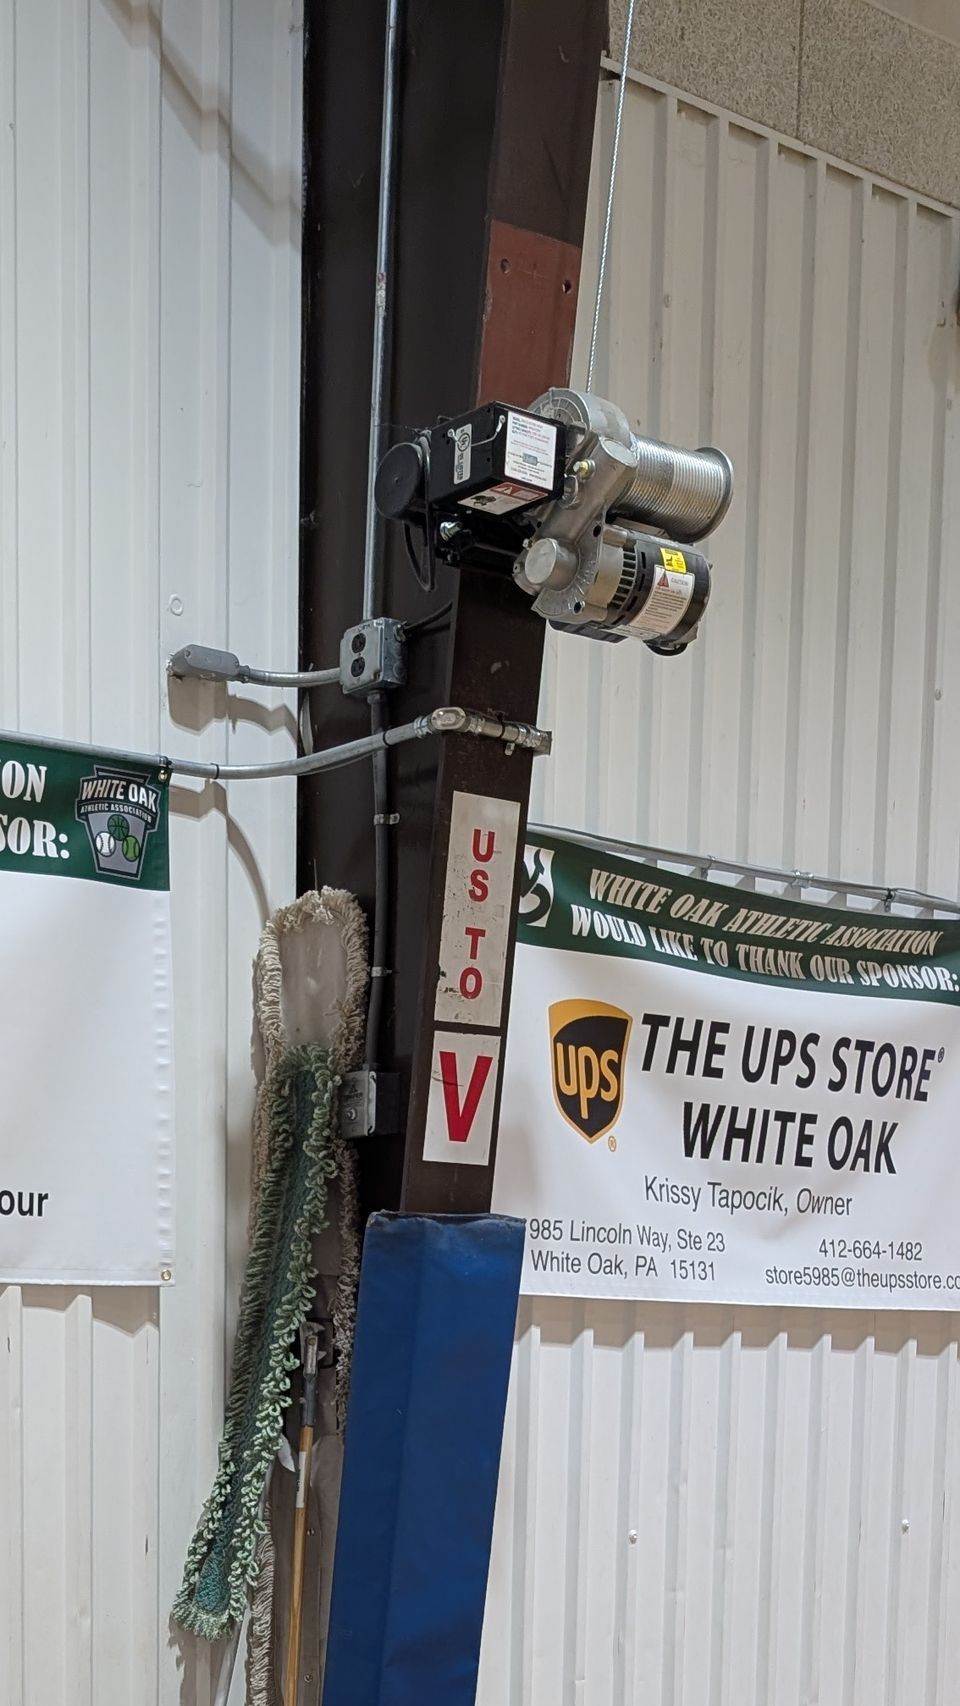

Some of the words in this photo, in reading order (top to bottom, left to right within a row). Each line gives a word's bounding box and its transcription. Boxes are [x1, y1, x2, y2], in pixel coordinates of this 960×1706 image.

[80, 803, 109, 813] ATHLETIC
[111, 804, 152, 823] ASSOCIATION
[82, 779, 126, 800] WHITE
[128, 783, 157, 813] OAK
[589, 869, 671, 908] WHITE
[670, 894, 725, 928] OAK
[722, 908, 828, 944] ATHLETIC
[823, 926, 943, 956] ASSOCIATION
[571, 904, 647, 948] WOULD
[649, 927, 698, 960] LIKE
[700, 938, 729, 968] TO
[735, 943, 805, 980] THANK
[810, 954, 853, 984] OUR
[856, 960, 960, 992] SPONSOR:
[641, 1013, 730, 1079] THE
[741, 1025, 820, 1088] UPS
[439, 1051, 493, 1142] V
[555, 1042, 620, 1119] ups
[682, 1101, 818, 1168] WHITE
[827, 1116, 899, 1174] OAK
[645, 1175, 702, 1212] Krissy
[707, 1181, 789, 1216] Tapocik,
[796, 1187, 852, 1216] Owner
[570, 1220, 632, 1245] Lincoln
[636, 1225, 672, 1253] Way,
[676, 1228, 702, 1251] Ste
[706, 1232, 725, 1254] 23
[818, 1239, 922, 1262] 412-664-1482
[530, 1249, 581, 1273] White
[587, 1253, 627, 1281] Oak,
[635, 1256, 658, 1278] PA
[670, 1260, 715, 1282] 15131
[765, 1265, 960, 1293] store5985@theupsstore.co
